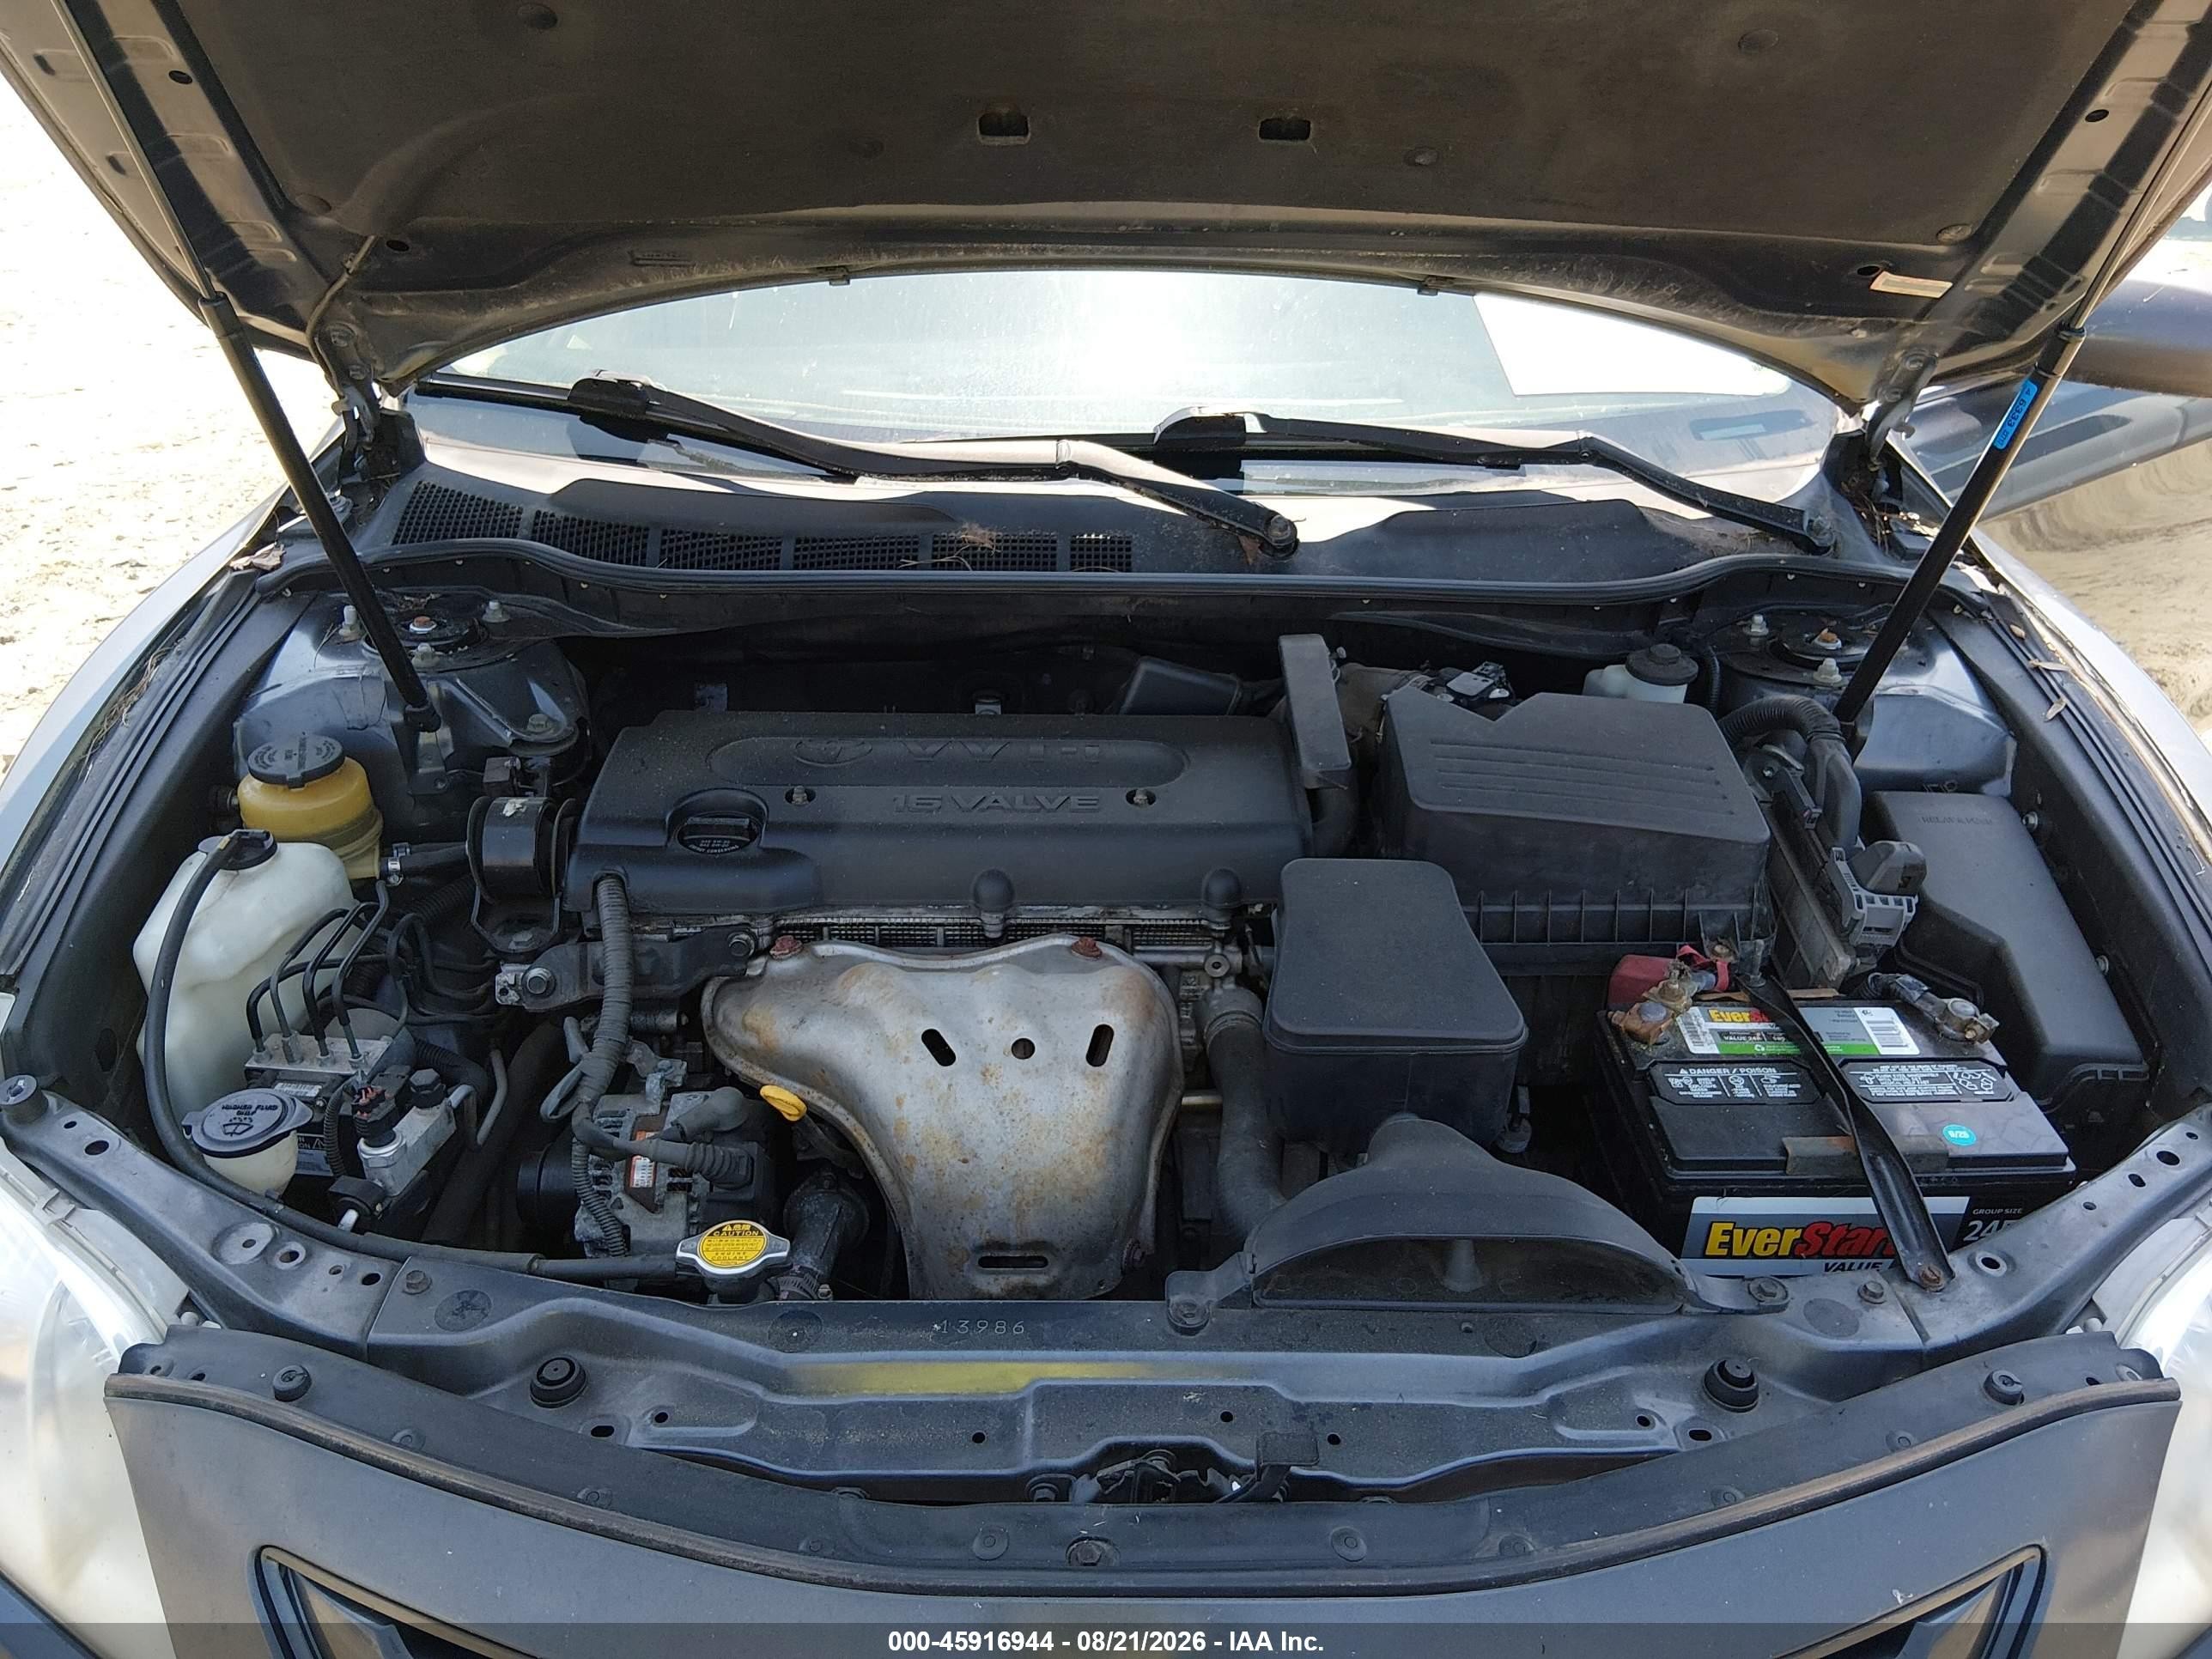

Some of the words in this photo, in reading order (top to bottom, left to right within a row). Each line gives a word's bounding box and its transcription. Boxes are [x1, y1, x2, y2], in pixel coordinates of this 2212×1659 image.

[893, 794, 943, 813] 16
[951, 794, 1100, 813] VALVE
[1824, 1261, 1884, 1273] VALUE
[941, 1320, 1024, 1334] 13986
